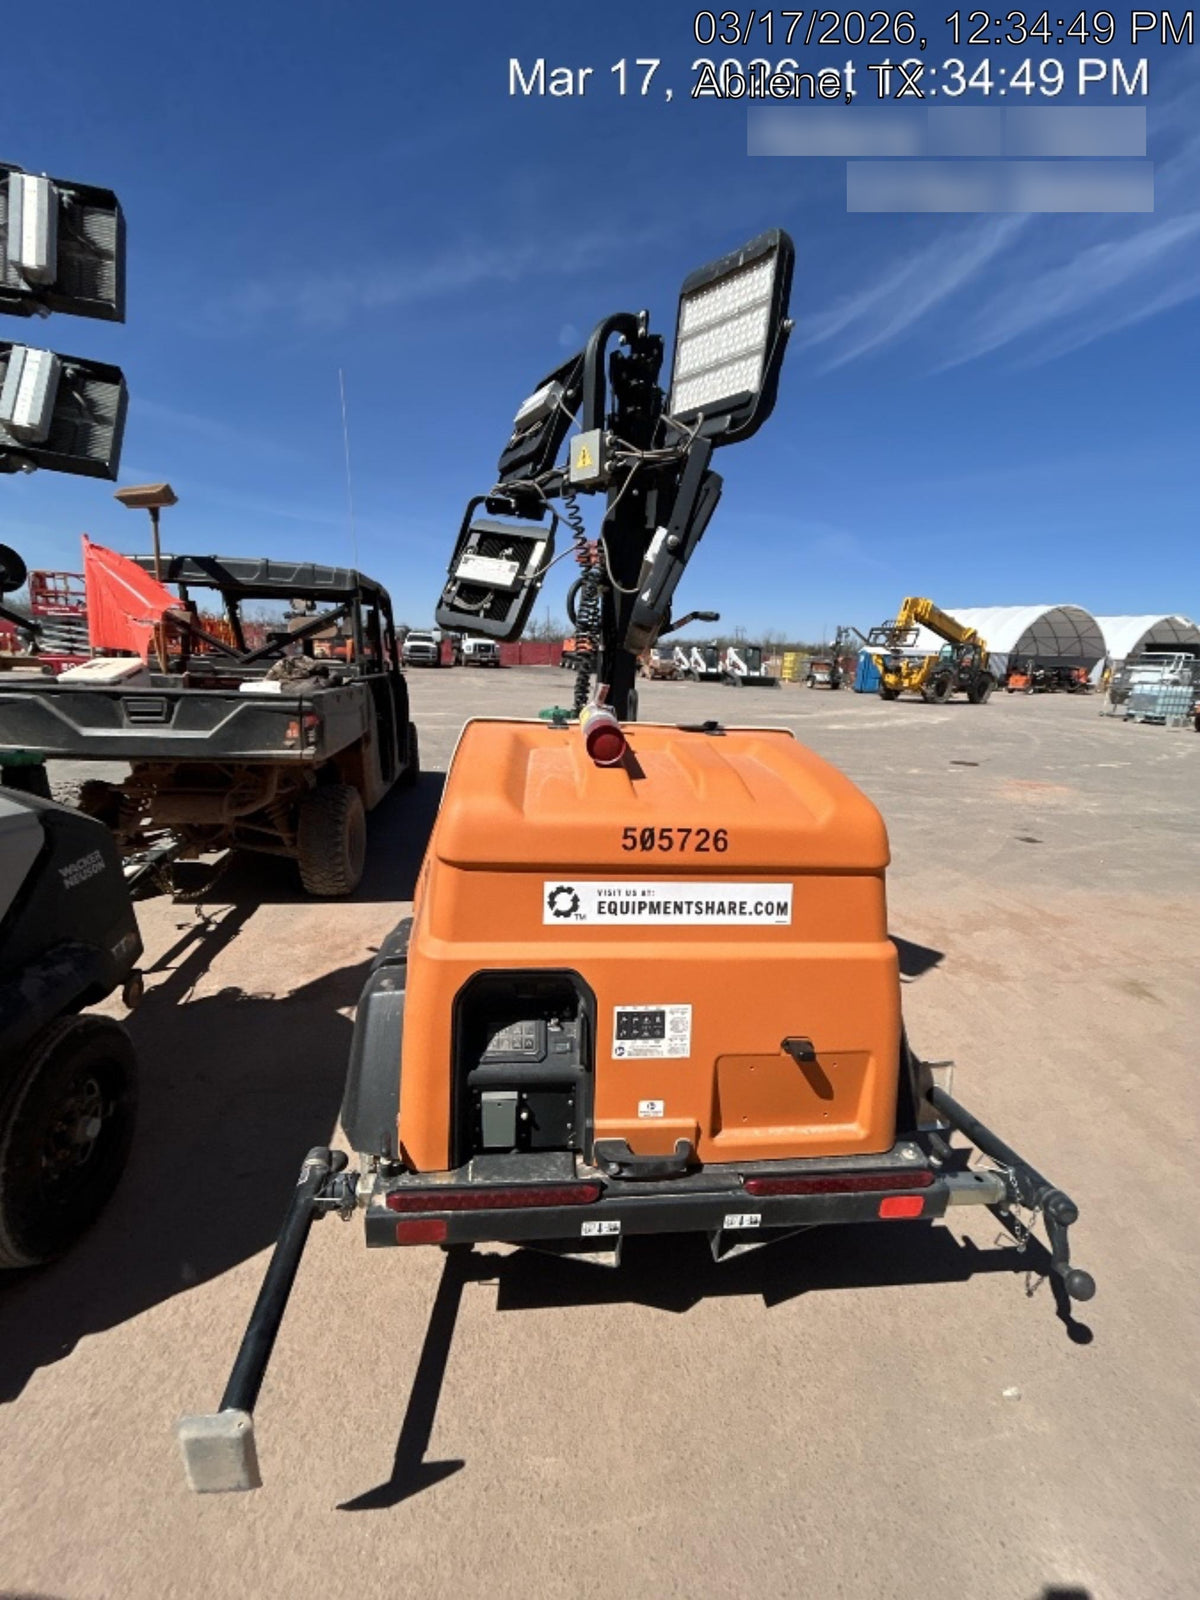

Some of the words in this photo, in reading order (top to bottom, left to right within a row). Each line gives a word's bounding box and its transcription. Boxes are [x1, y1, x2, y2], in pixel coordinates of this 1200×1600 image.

[621, 827, 728, 853] 505726
[59, 850, 104, 877] WACKER
[64, 862, 105, 888] NEUSON
[597, 889, 621, 898] VISIT
[625, 889, 637, 898] US
[597, 900, 789, 917] EQUIPMENTSHARE.COM
